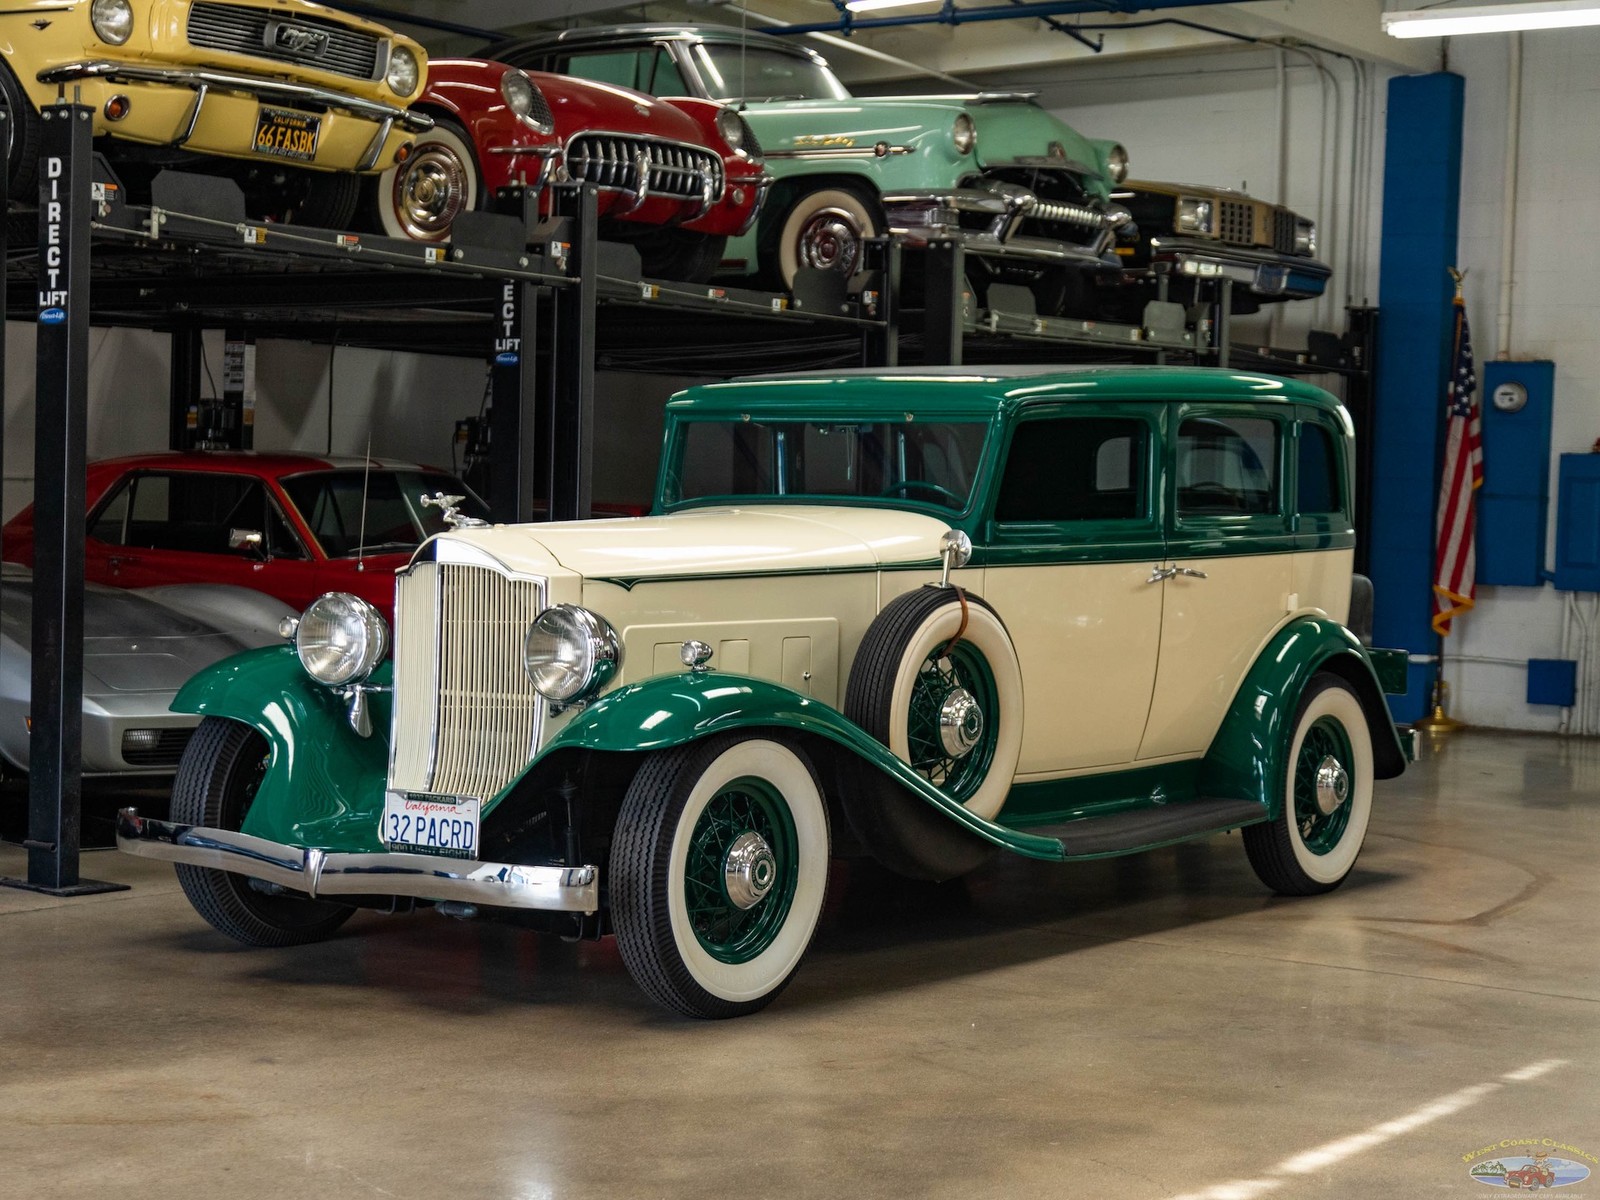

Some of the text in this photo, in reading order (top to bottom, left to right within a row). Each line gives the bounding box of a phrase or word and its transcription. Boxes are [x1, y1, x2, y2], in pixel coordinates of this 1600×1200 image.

[257, 124, 276, 146] 66
[275, 127, 316, 153] FASBK
[46, 157, 63, 289] DIRECT
[39, 290, 68, 307] LIFT
[495, 338, 521, 352] LIFT
[424, 794, 455, 804] PACKARD
[405, 800, 462, 816] California
[389, 813, 474, 849] 32 PACRD
